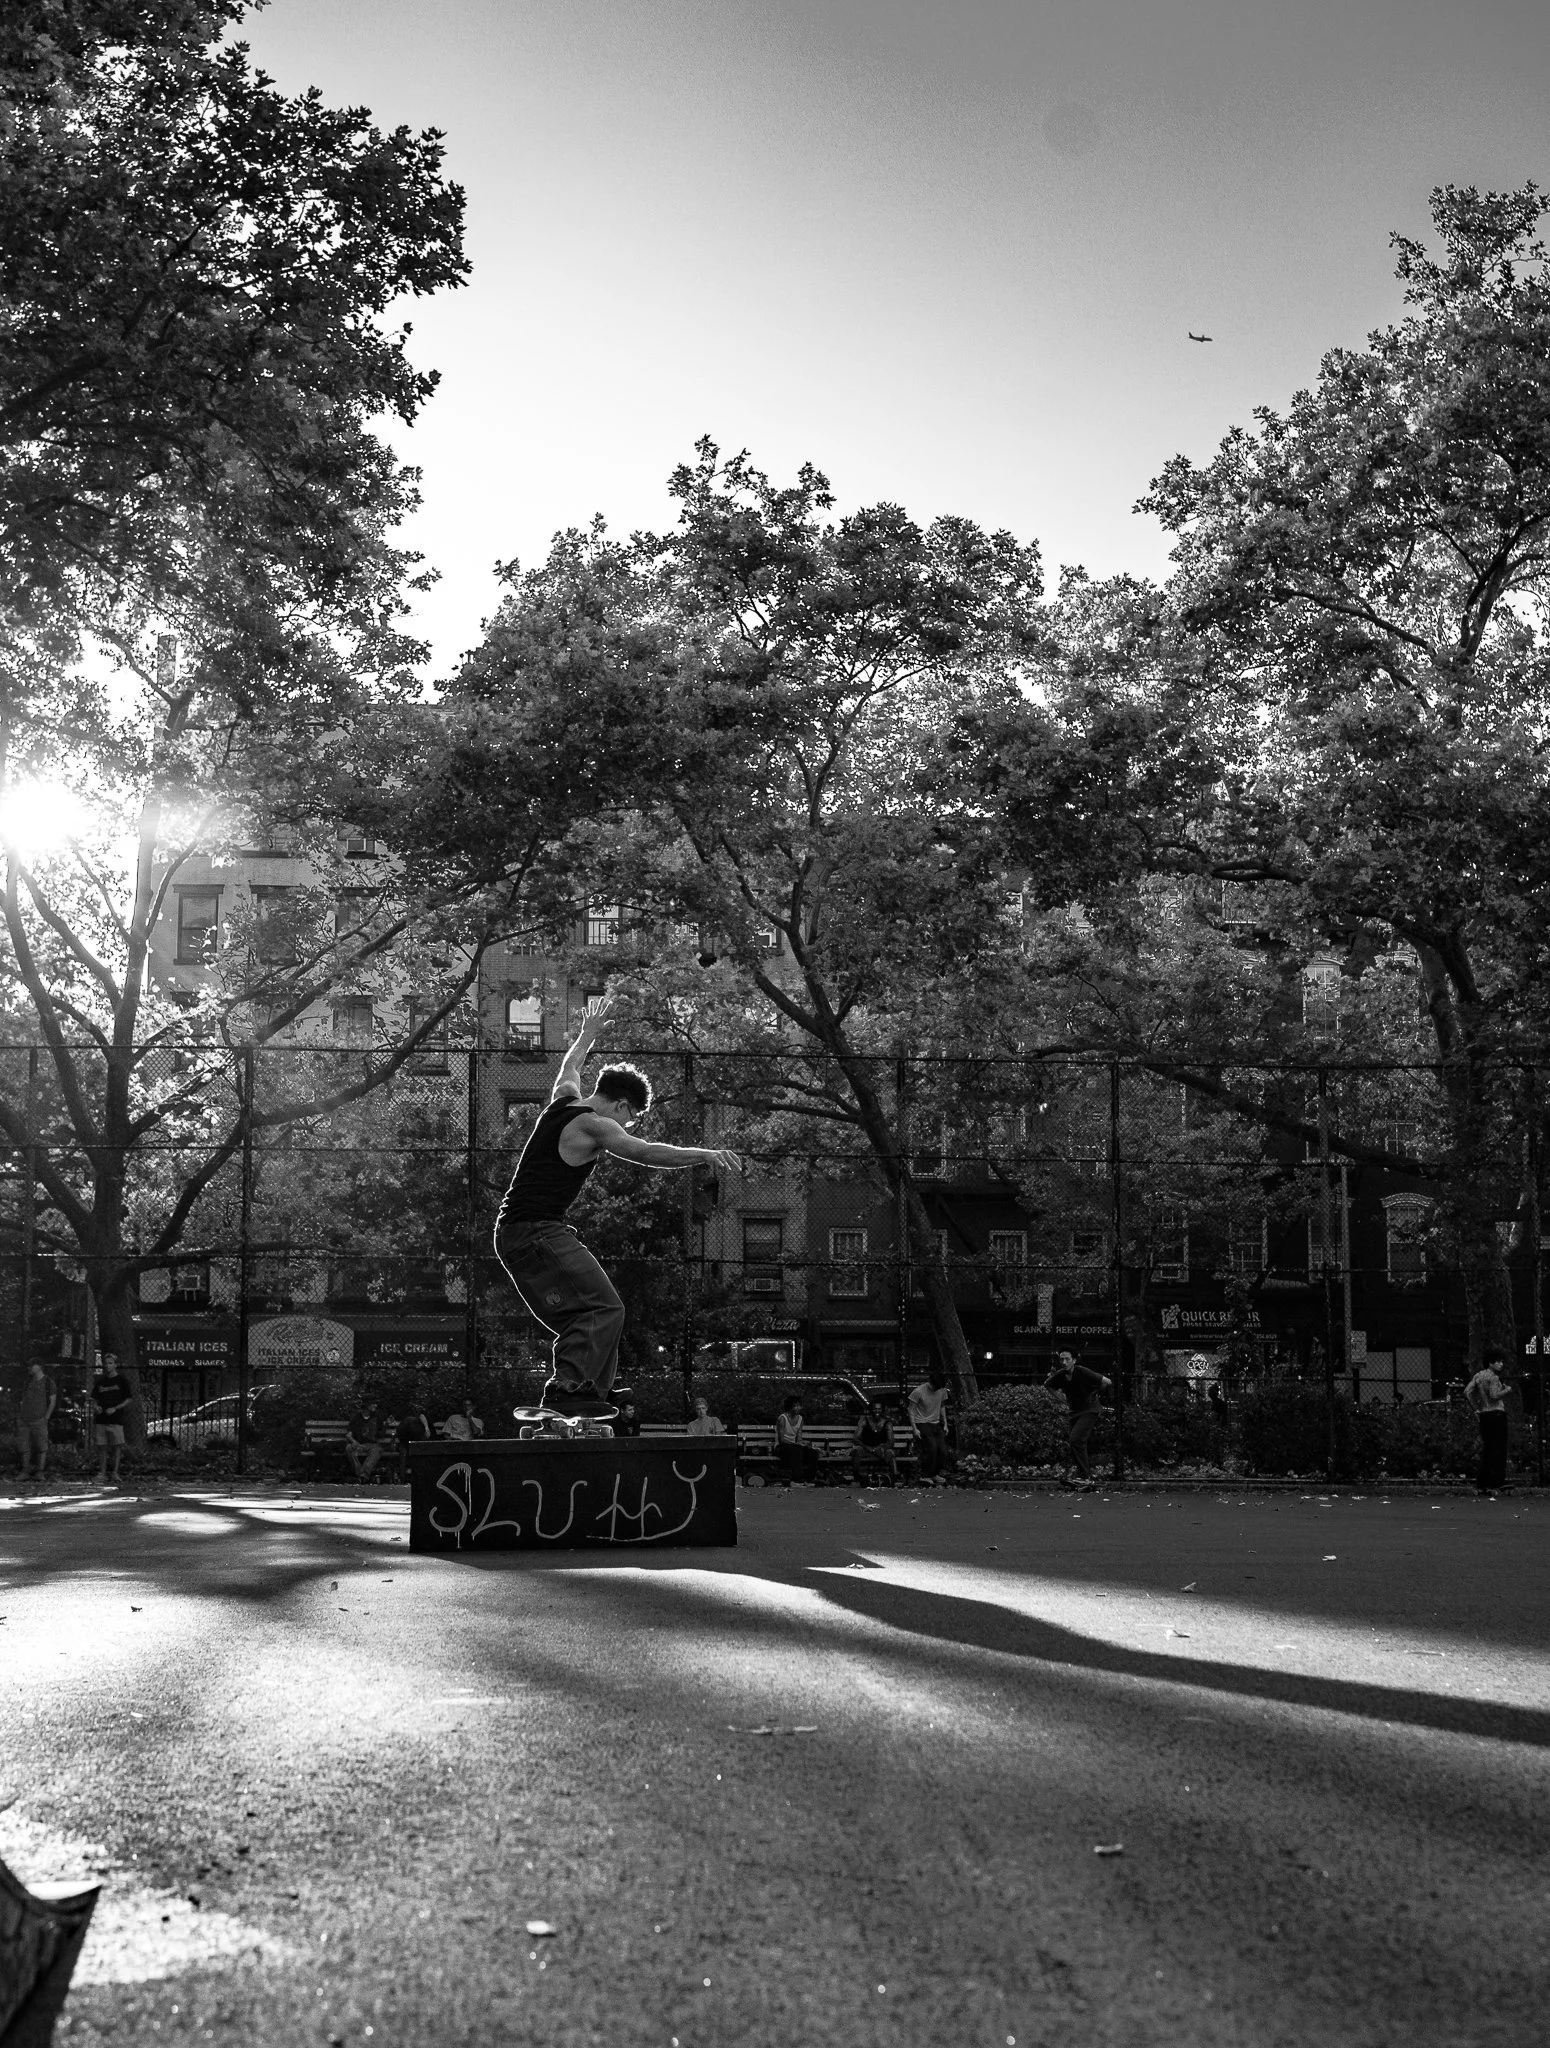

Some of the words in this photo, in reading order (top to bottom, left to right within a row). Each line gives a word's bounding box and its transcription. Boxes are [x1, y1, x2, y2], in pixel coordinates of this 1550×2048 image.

[1180, 1310, 1217, 1323] QUICK
[1218, 1310, 1261, 1322] REIR
[1013, 1325, 1043, 1334] BLANK
[1079, 1326, 1114, 1334] COFFEE
[146, 1341, 196, 1352] ITALIAN
[199, 1342, 229, 1352] ICES
[380, 1343, 401, 1353] ICE
[404, 1343, 448, 1353] CREAM
[299, 1349, 321, 1357] ICES
[148, 1359, 185, 1367] SUNDAES
[193, 1359, 226, 1367] SHAKES
[1186, 1360, 1210, 1370] OPEN
